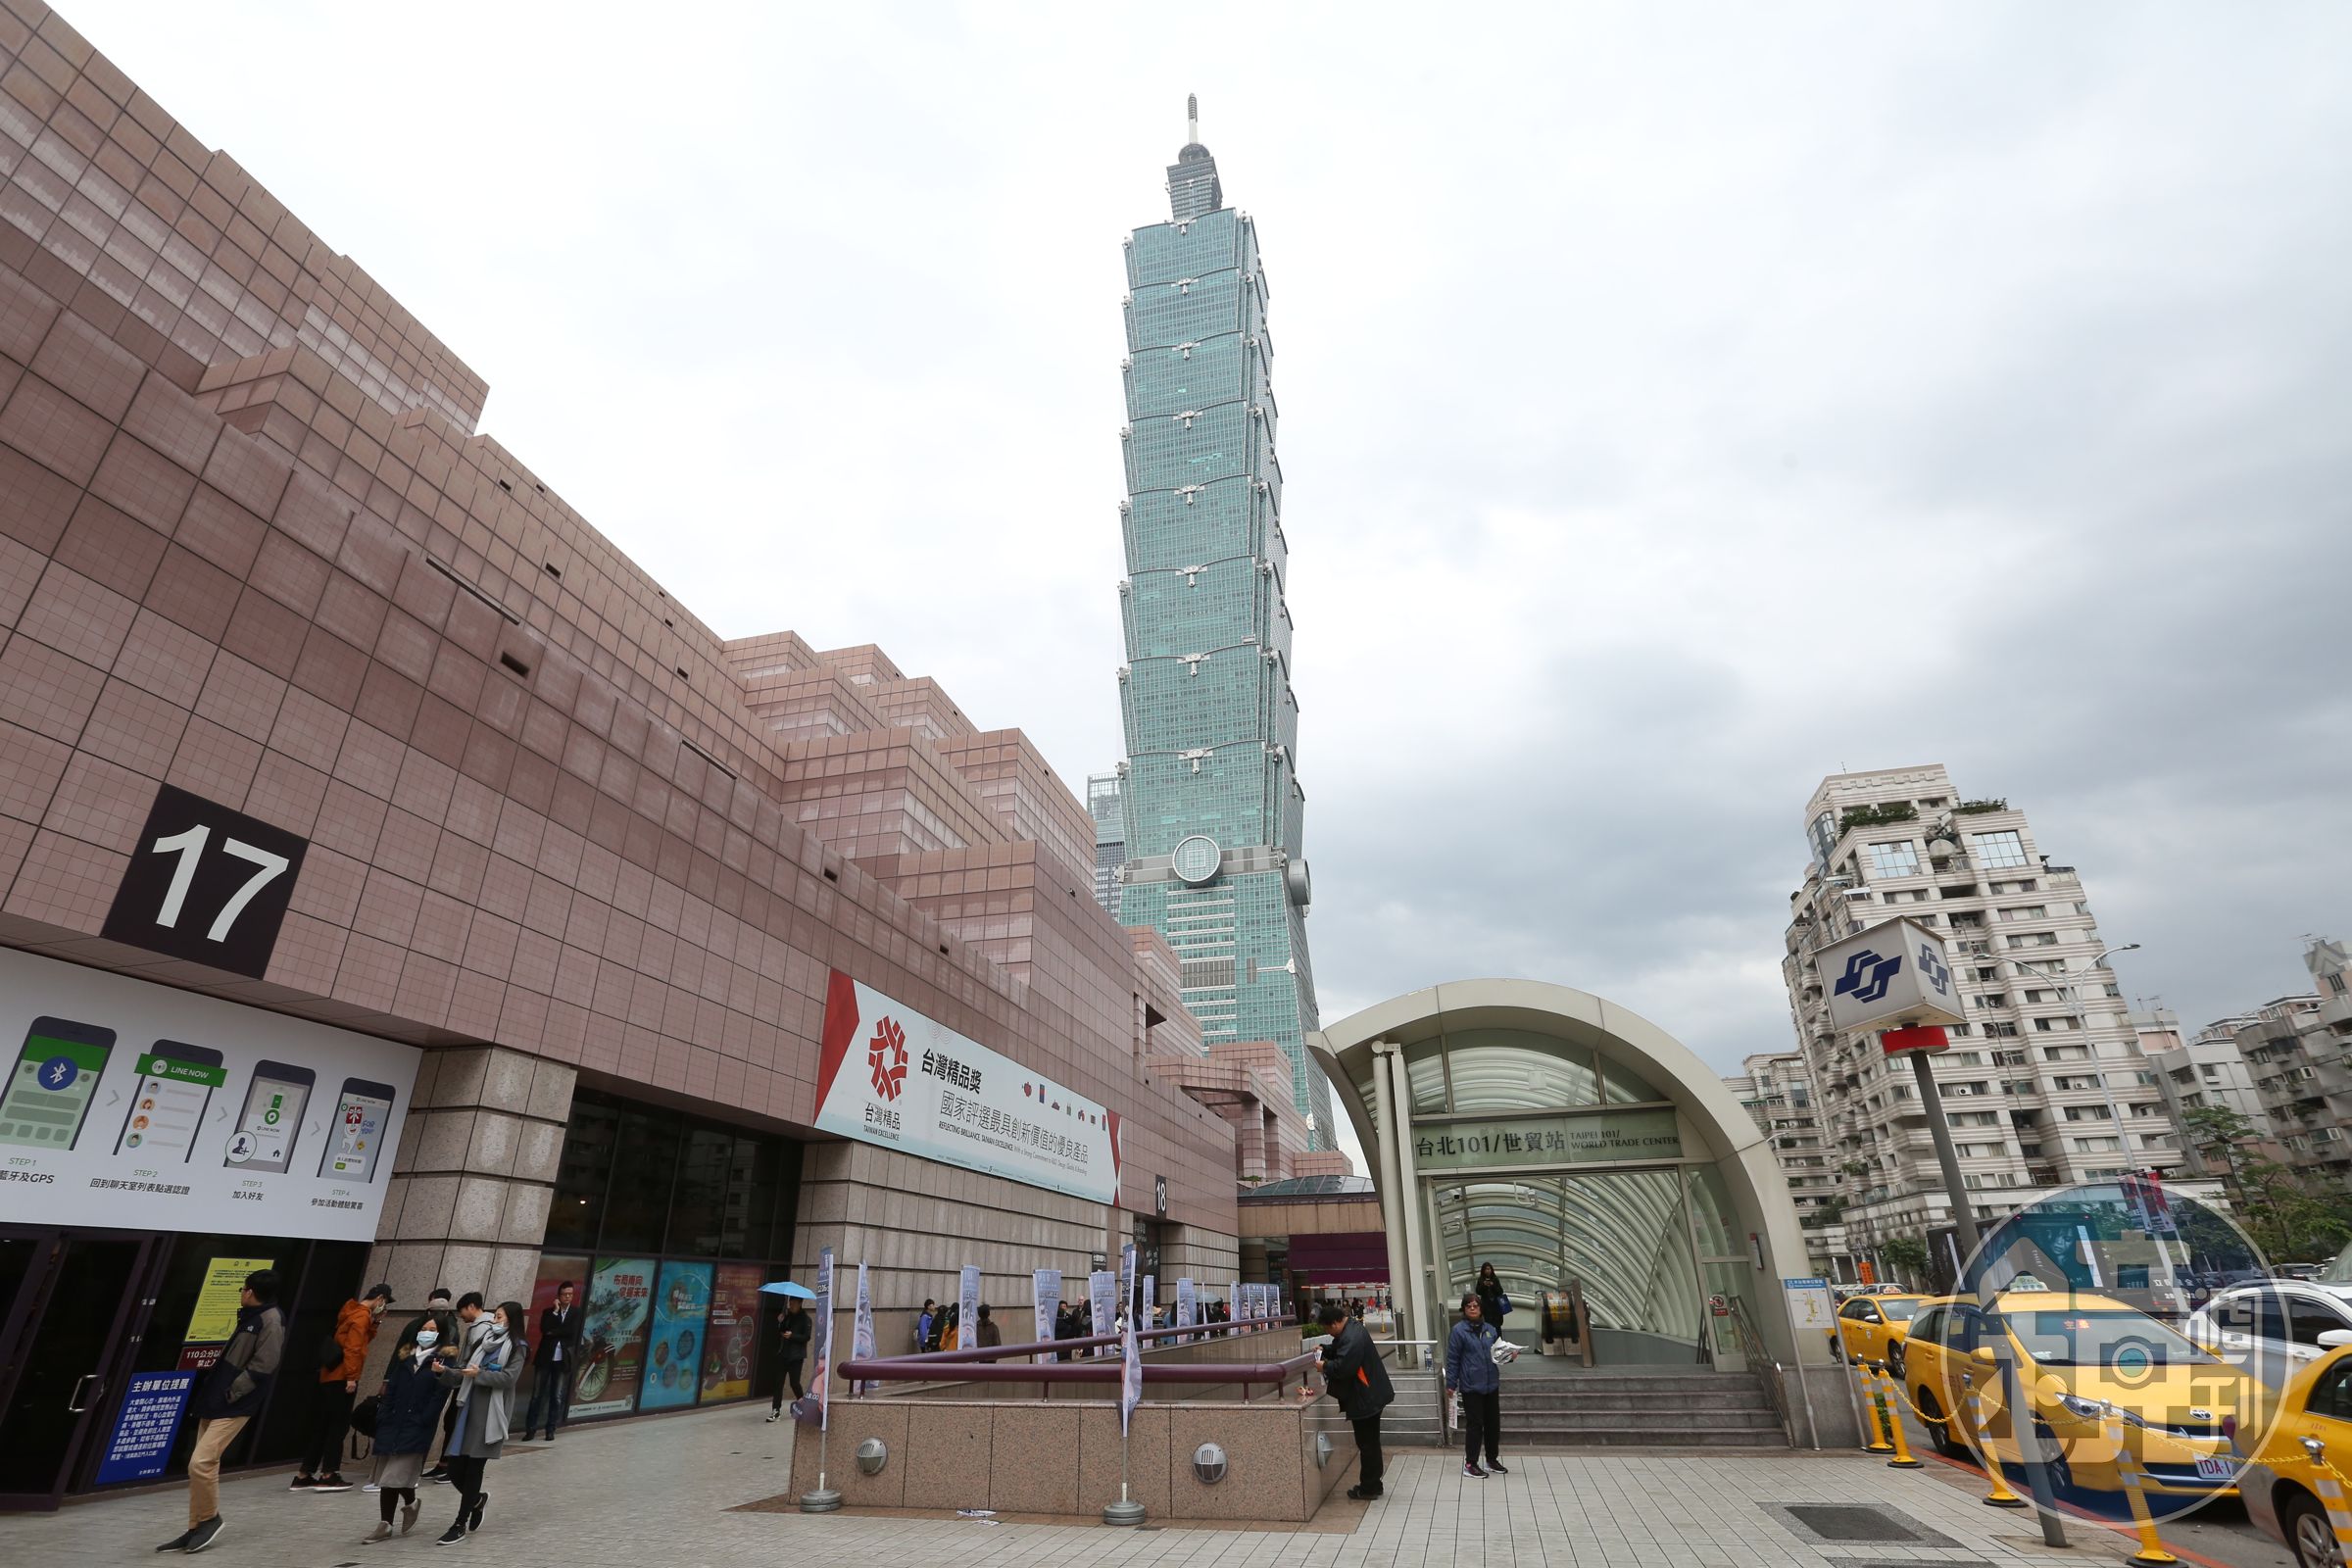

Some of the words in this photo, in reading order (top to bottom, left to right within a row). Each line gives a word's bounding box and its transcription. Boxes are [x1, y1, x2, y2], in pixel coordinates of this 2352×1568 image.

[152, 823, 290, 944] 17
[171, 1066, 189, 1075] LINE
[189, 1069, 209, 1079] NOW
[921, 1048, 982, 1095] 台灣精品獎
[865, 1102, 901, 1131] 台灣精品
[863, 1124, 878, 1136] TAIWAN
[878, 1127, 900, 1142] EXCELLENCE
[940, 1090, 1089, 1164] 國家評選最具創新價值的優良產品
[1570, 1130, 1598, 1140] TAIPEI
[1601, 1129, 1620, 1139] 101/
[1417, 1131, 1565, 1157] 台北101/世貿站
[1571, 1140, 1607, 1150] WORLD
[1610, 1138, 1640, 1148] TRADE
[1642, 1136, 1680, 1146] CENTER
[9, 1157, 31, 1166] STEP
[89, 1178, 190, 1196] 回到聊天室列表點選認證
[232, 1191, 265, 1201] 加入好友
[1156, 1181, 1166, 1212] 18
